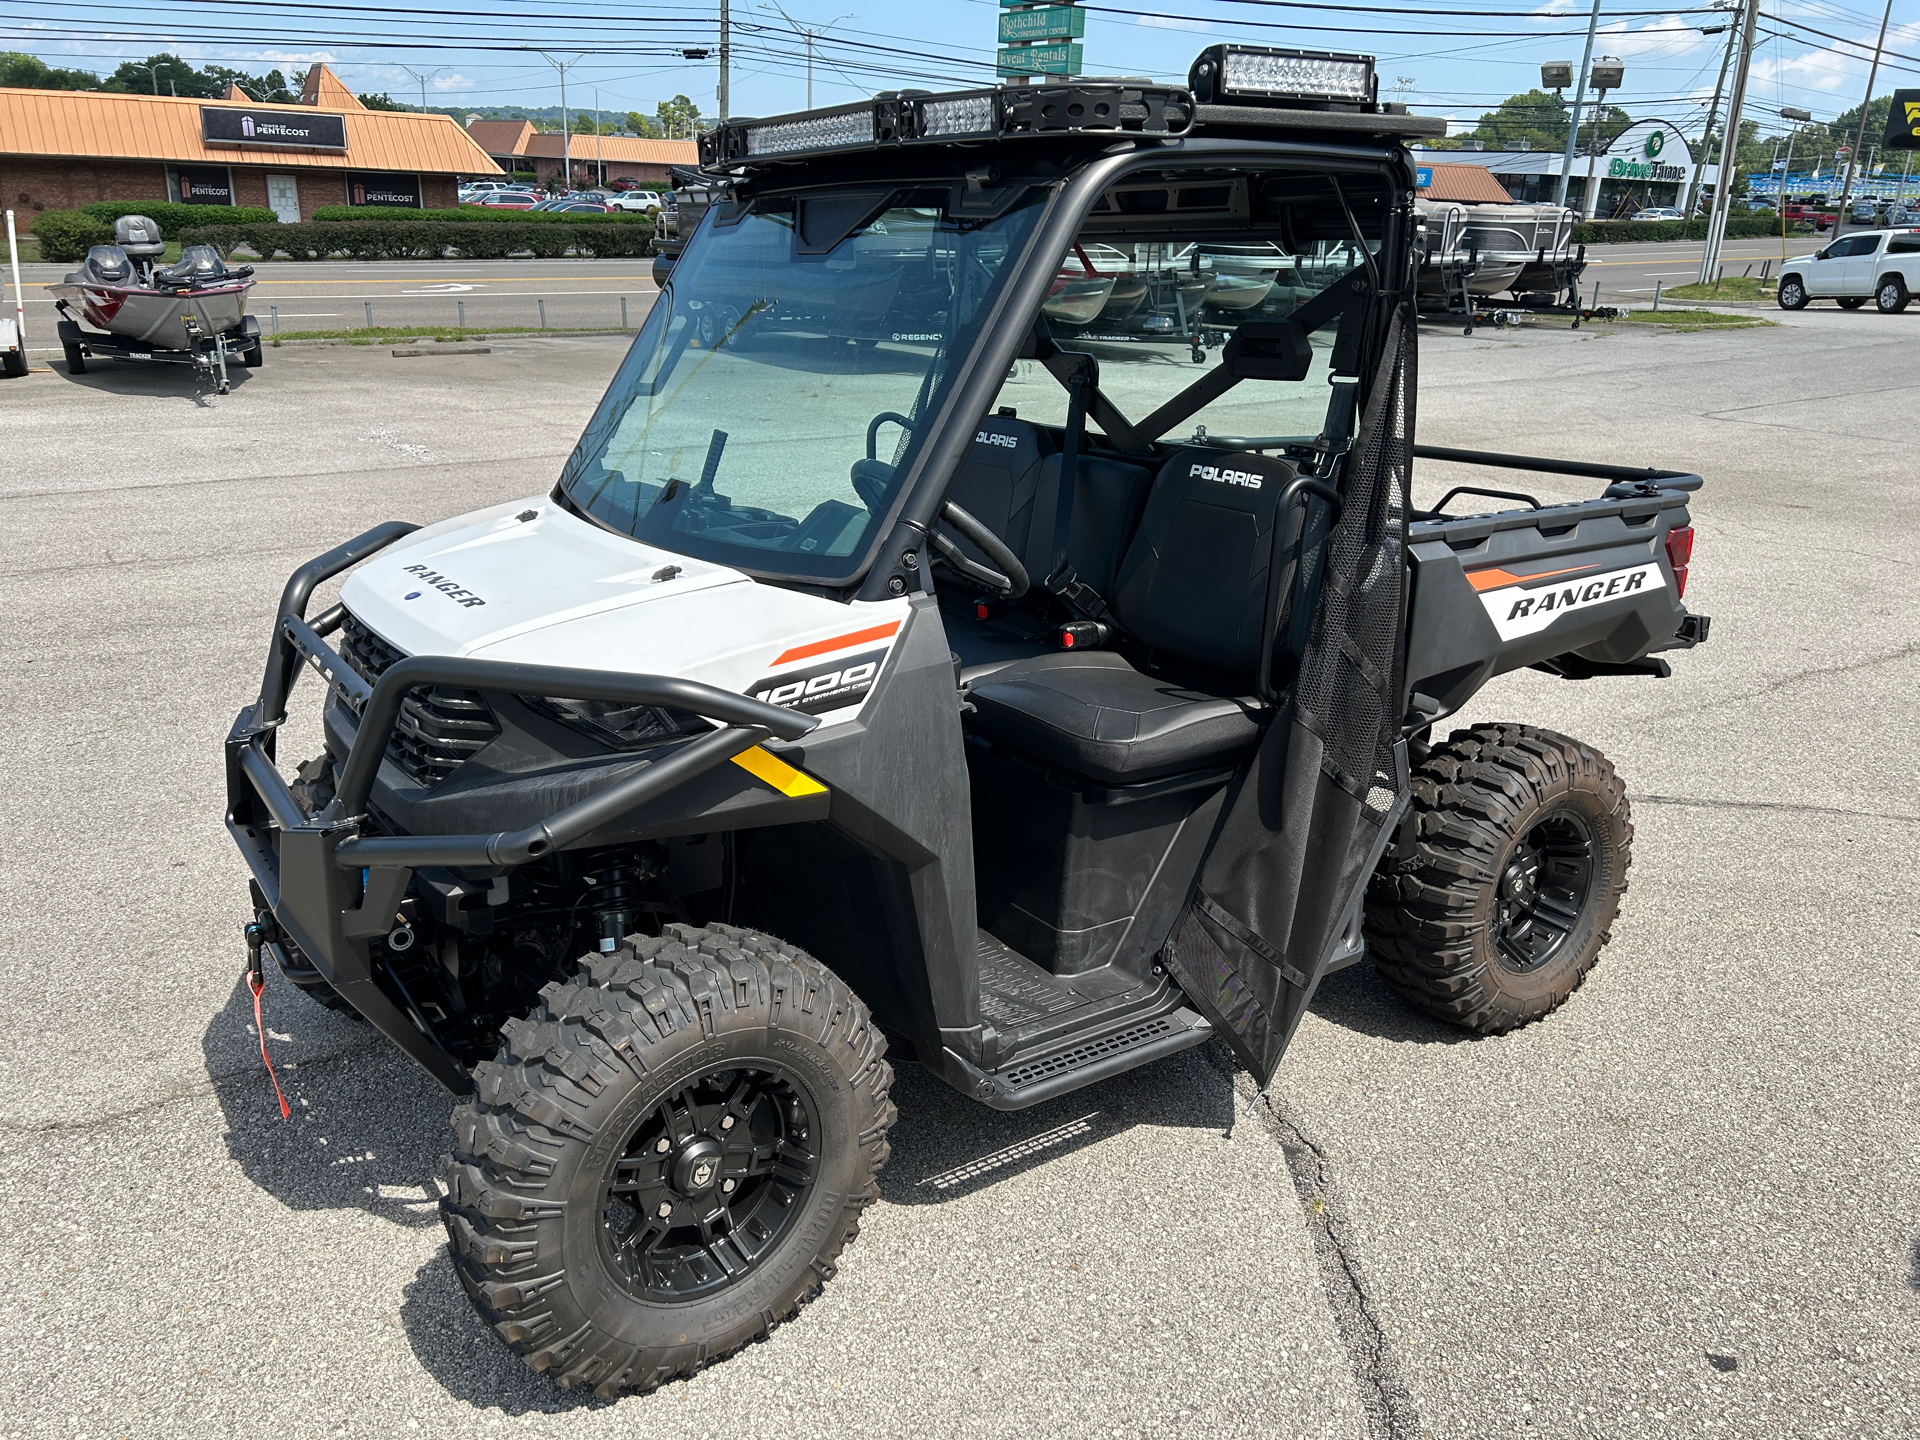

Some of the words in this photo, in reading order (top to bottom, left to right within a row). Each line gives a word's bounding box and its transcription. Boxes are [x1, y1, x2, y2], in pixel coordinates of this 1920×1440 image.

[1001, 12, 1046, 36] Rothchild
[1017, 29, 1047, 38] CONFERENCE
[1048, 27, 1068, 35] CENTER
[999, 51, 1025, 65] Event
[1030, 47, 1066, 68] Rentals
[256, 127, 310, 137] PENTECOST
[1611, 157, 1686, 180] DriveTime
[191, 187, 229, 196] PENTECOST
[366, 194, 414, 202] PENTECOST
[975, 431, 1018, 449] OLARIS
[1189, 463, 1264, 490] POLARIS
[402, 564, 486, 608] RANGER
[1506, 571, 1647, 622] RANGER
[755, 661, 877, 703] 1000
[802, 686, 850, 703] OVERHEAD
[851, 679, 872, 690] CAM
[640, 1042, 726, 1106] ARMOR
